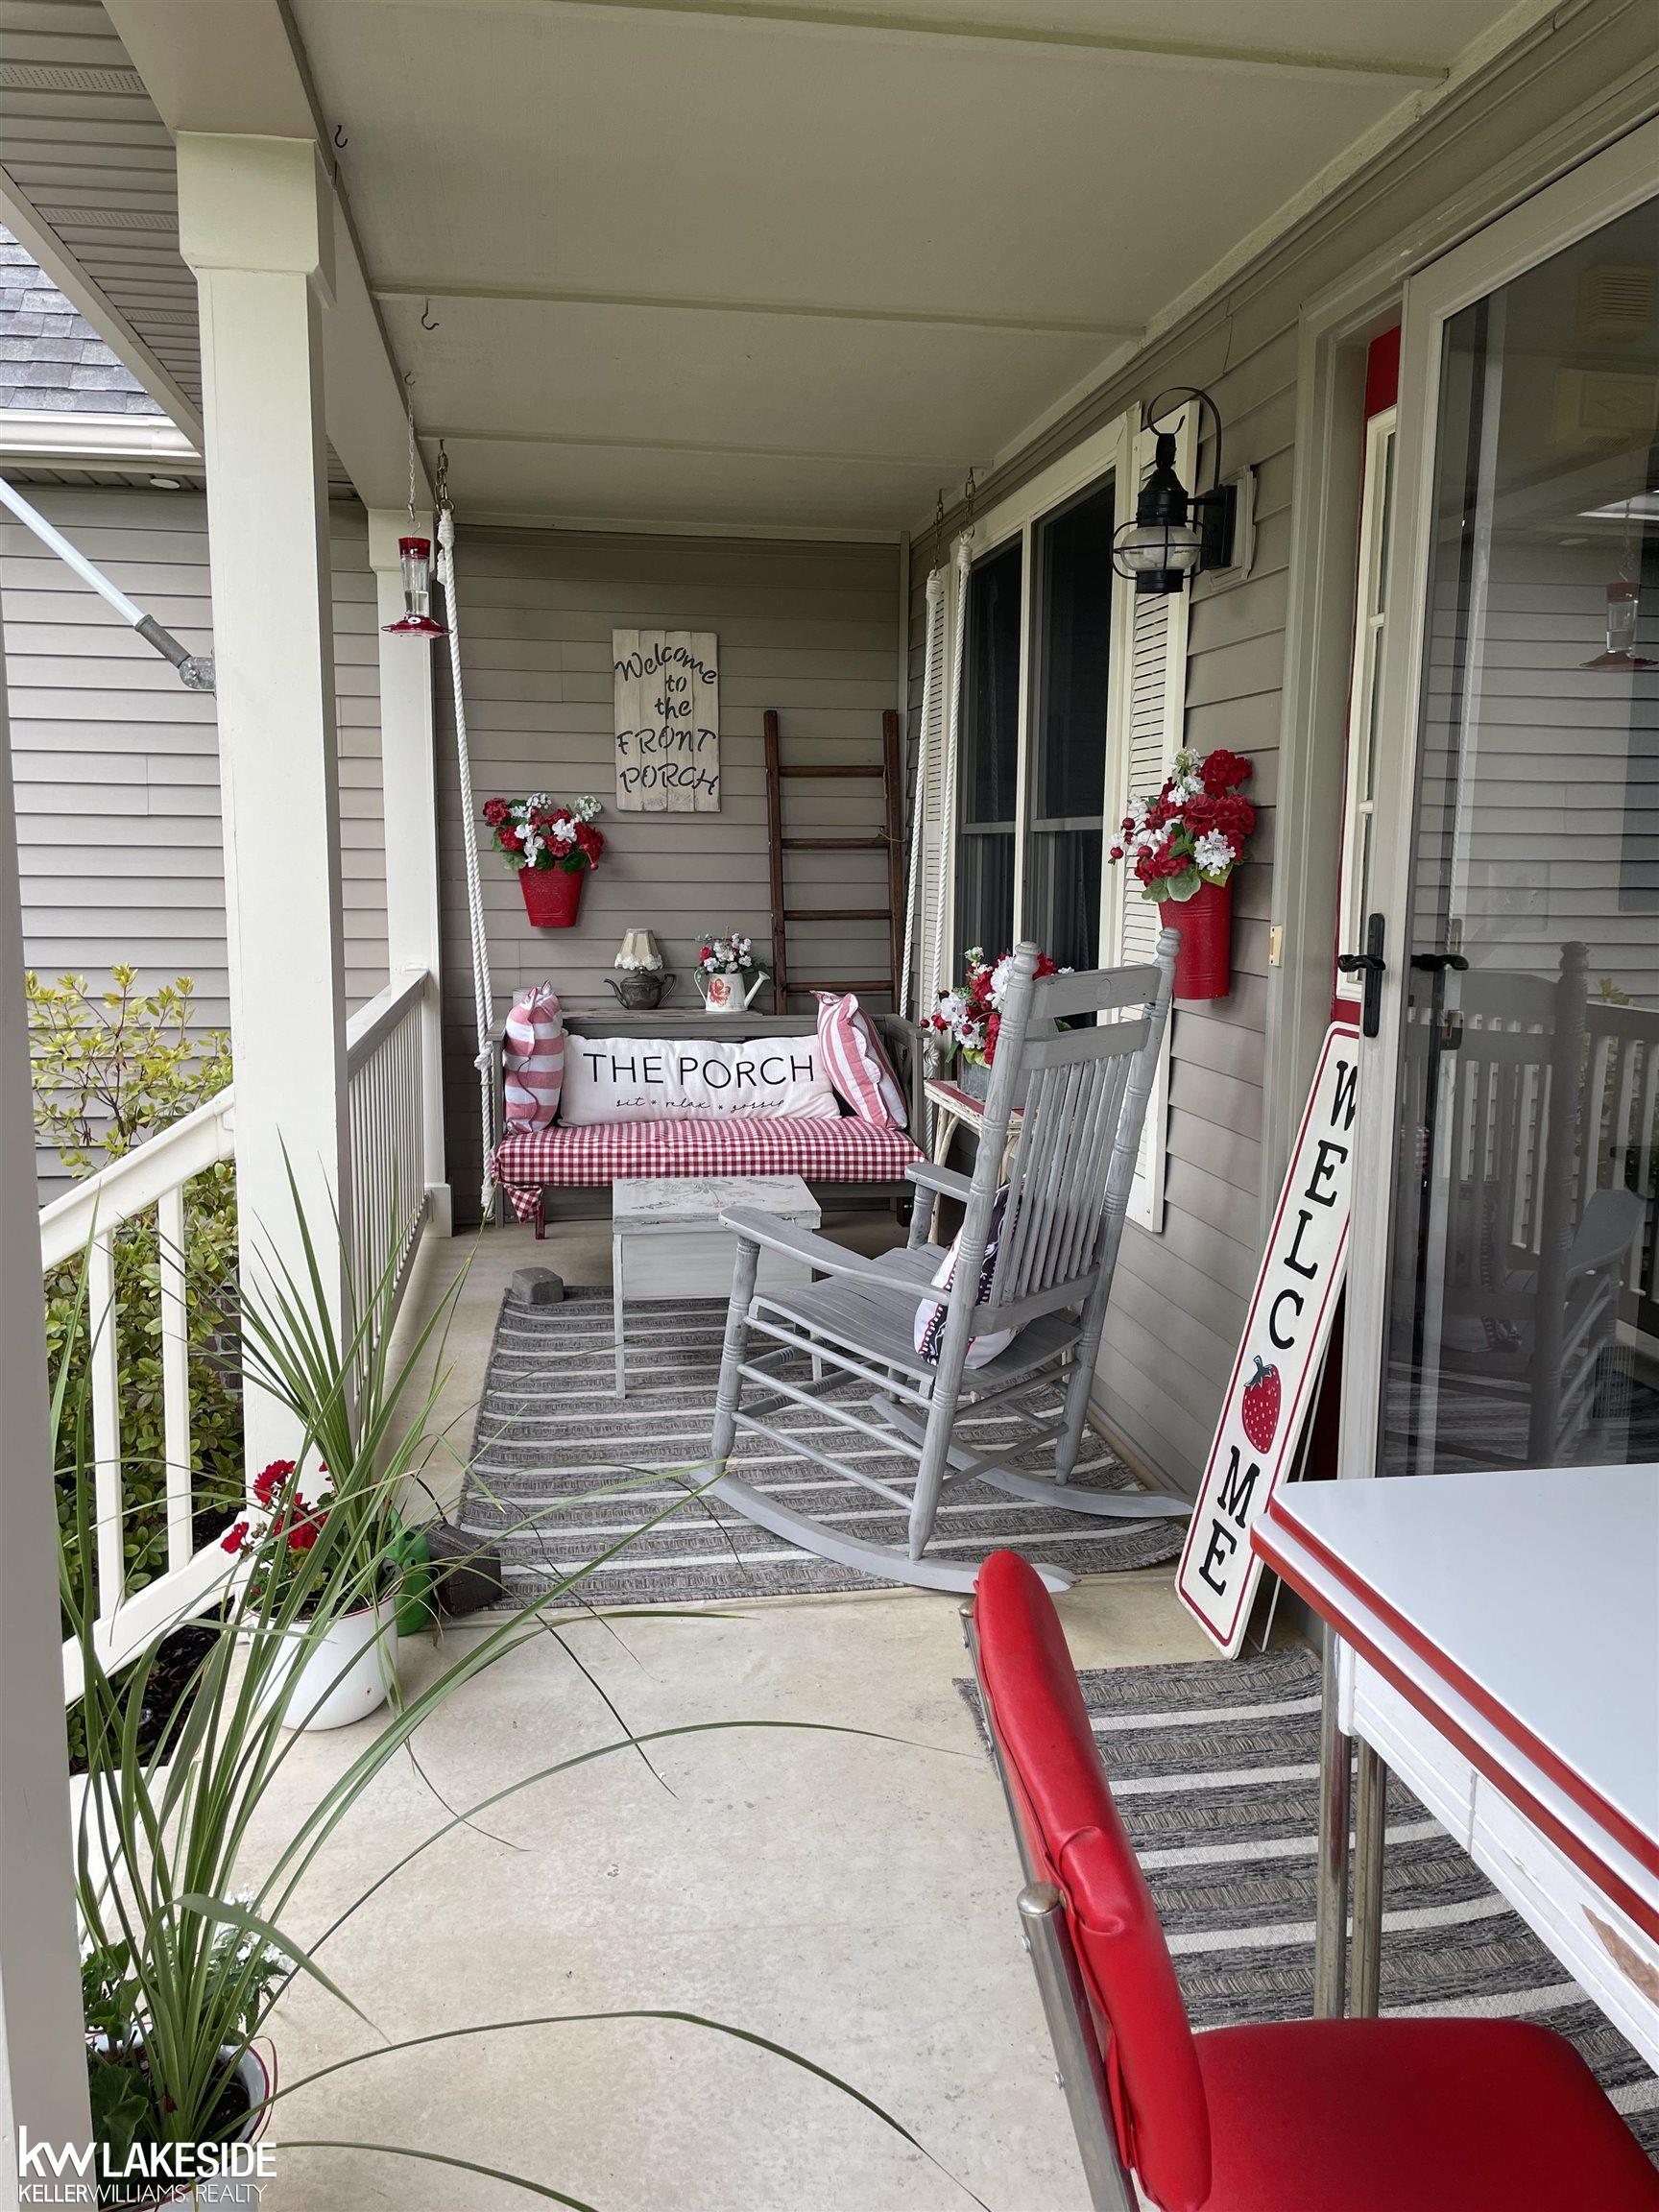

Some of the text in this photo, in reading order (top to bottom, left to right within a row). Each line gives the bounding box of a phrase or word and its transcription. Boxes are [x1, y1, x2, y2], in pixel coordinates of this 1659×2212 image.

[614, 643, 717, 685] Welcome
[664, 674, 687, 692] to
[655, 697, 692, 720] the
[616, 726, 717, 755] FRONT
[619, 763, 719, 796] PORCH
[583, 1053, 814, 1089] THE PORCH
[616, 1096, 784, 1114] sit relax gossip
